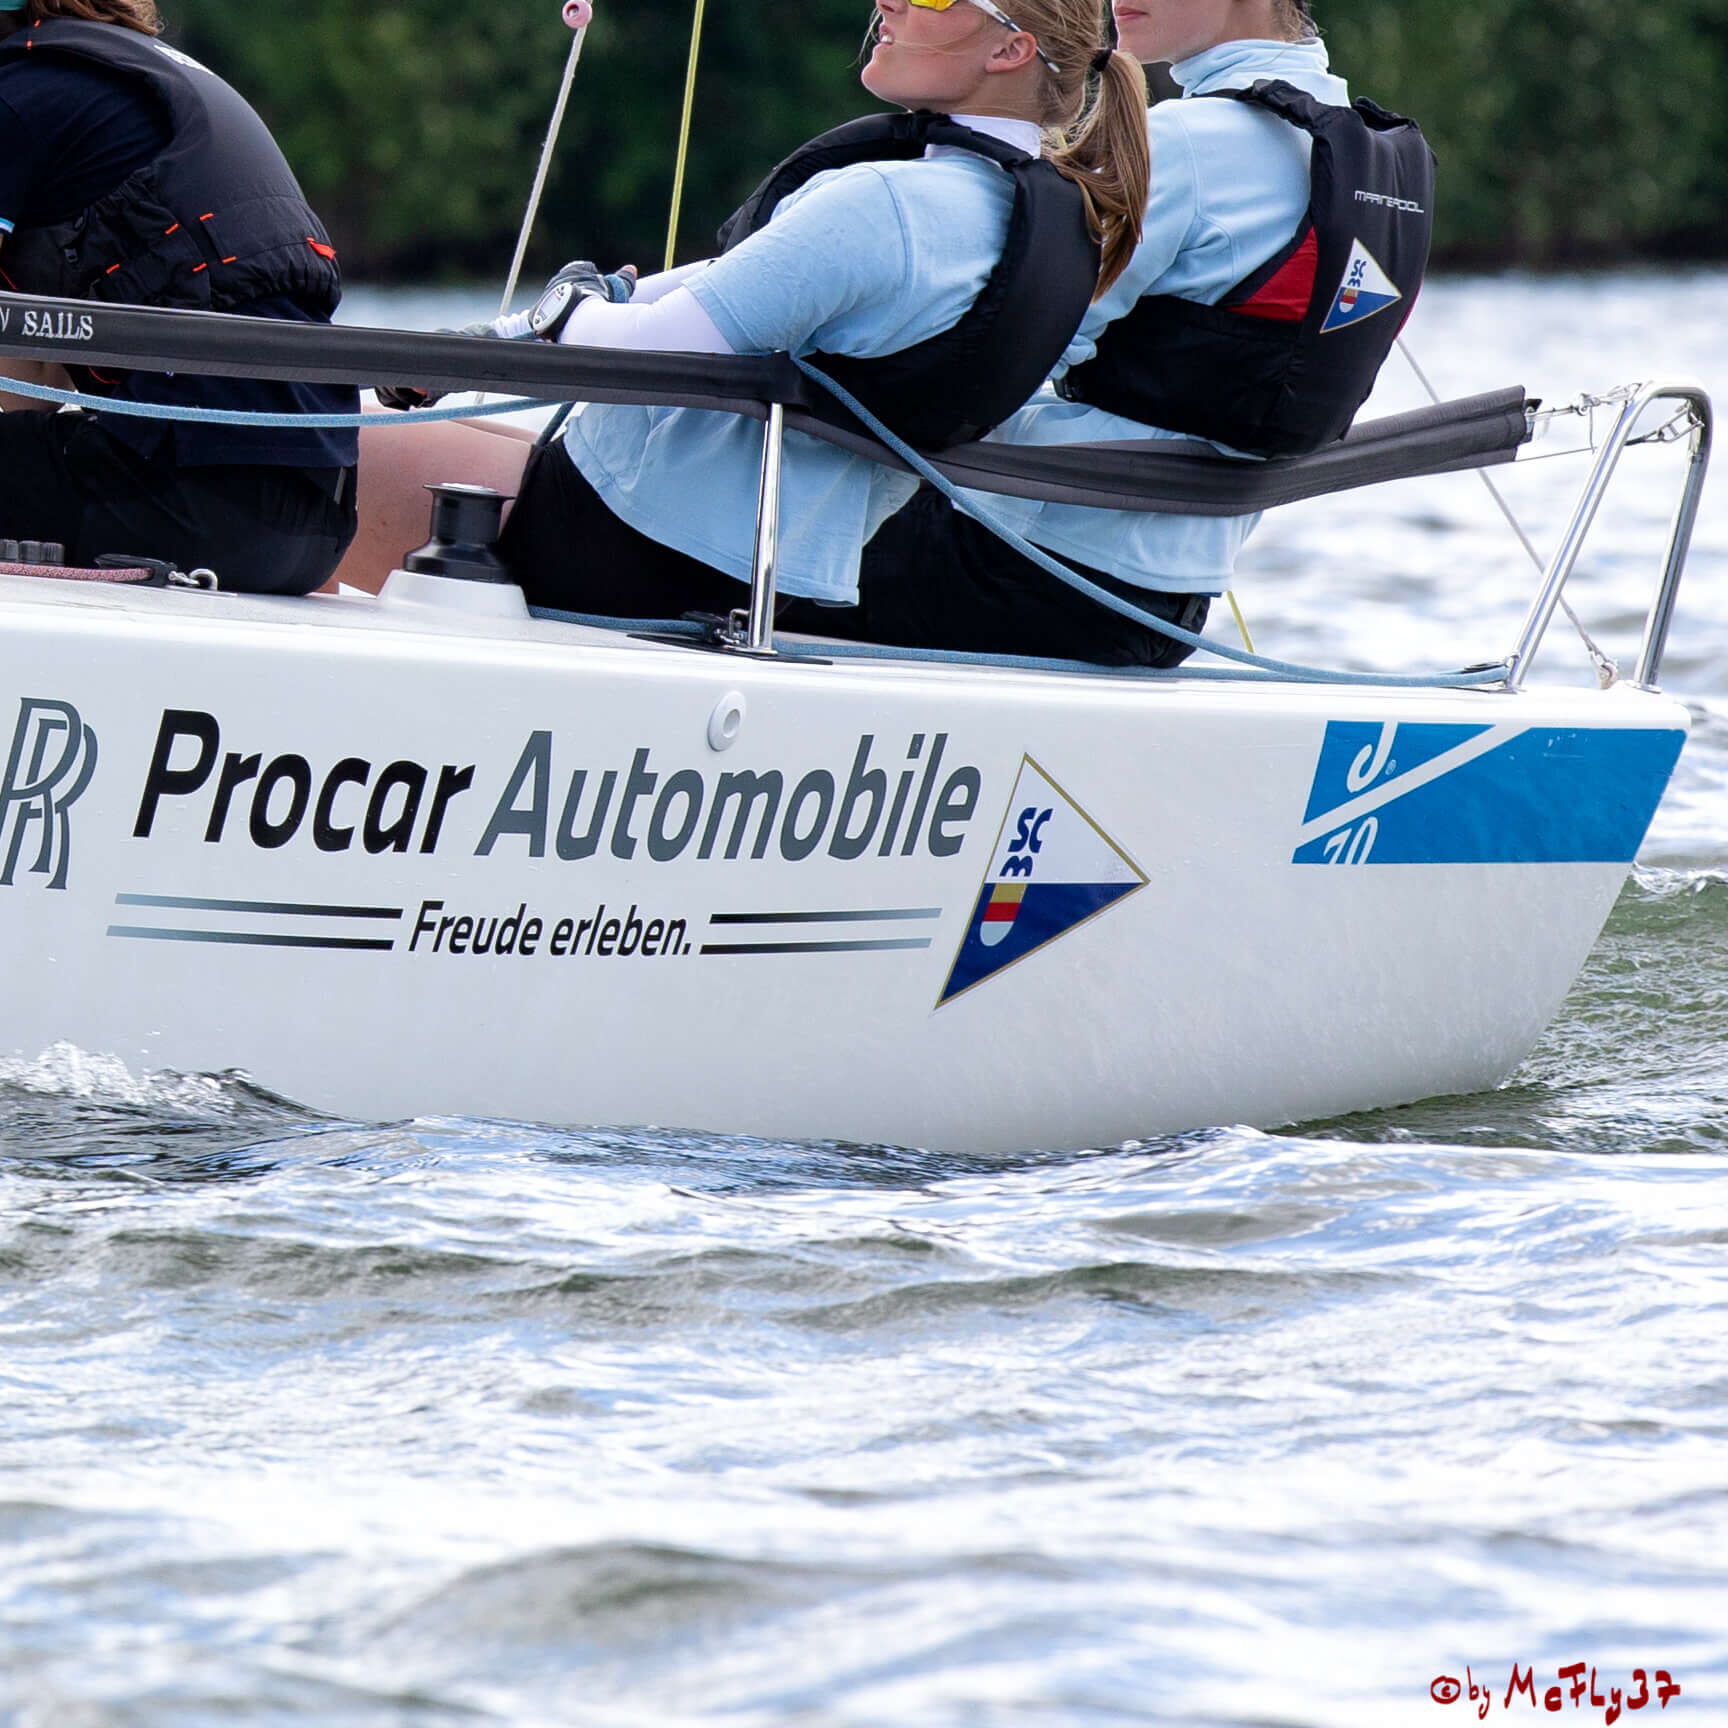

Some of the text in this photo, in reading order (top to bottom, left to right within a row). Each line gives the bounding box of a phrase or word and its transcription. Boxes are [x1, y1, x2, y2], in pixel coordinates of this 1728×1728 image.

[22, 311, 93, 340] SAILS
[132, 709, 981, 862] Procar Automobile
[1323, 817, 1378, 864] 70
[408, 900, 692, 956] Freude erleben.
